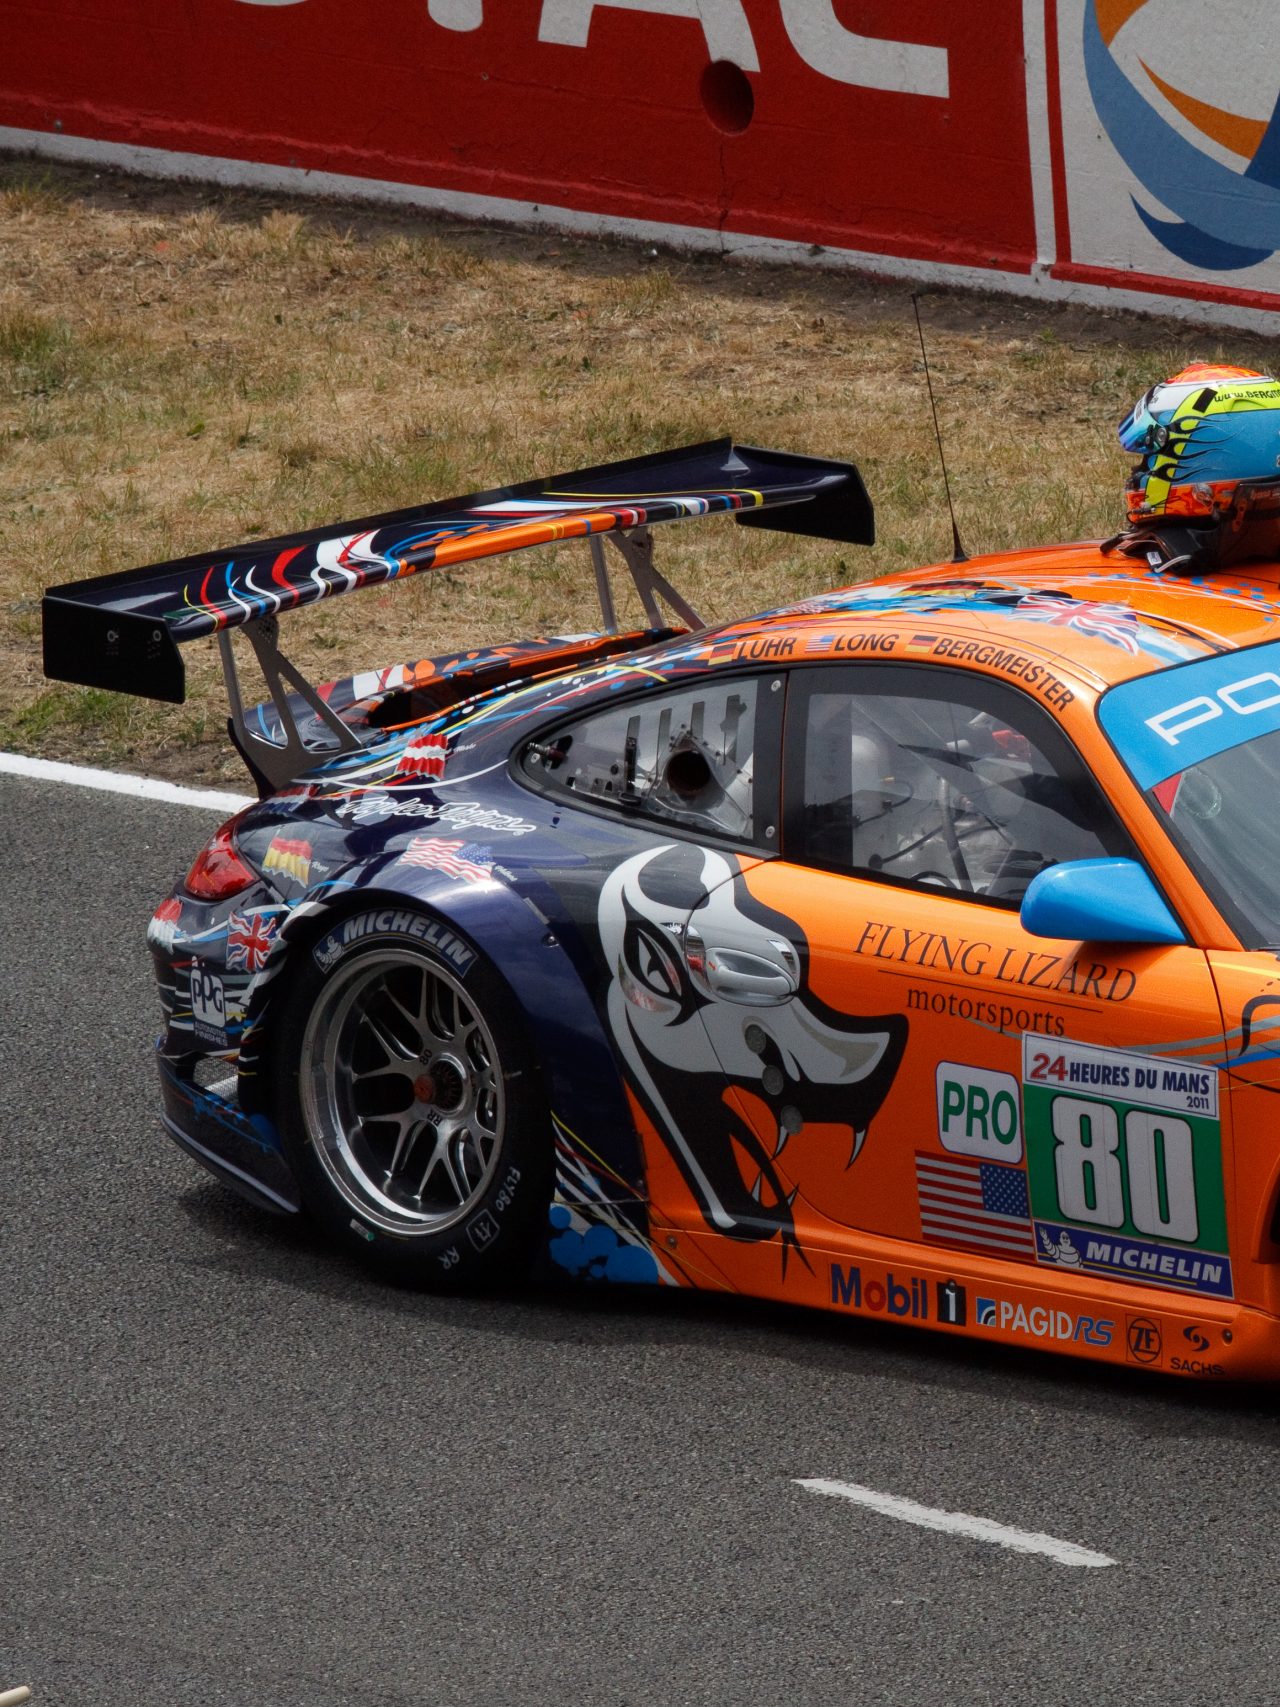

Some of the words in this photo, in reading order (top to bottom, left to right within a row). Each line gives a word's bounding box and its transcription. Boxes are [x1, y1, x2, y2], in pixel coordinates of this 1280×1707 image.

[737, 636, 797, 660] LUHR
[834, 634, 899, 653] LONG
[933, 638, 1076, 713] BERGMEISTER
[343, 910, 473, 966] MICHELIN
[853, 921, 992, 977] FLYING
[994, 948, 1137, 1002] LIZARD
[192, 967, 223, 1013] PPG
[906, 988, 1065, 1036] motorsports
[1030, 1053, 1068, 1081] 24
[1069, 1062, 1130, 1087] HEURES
[1134, 1068, 1157, 1090] DU
[1162, 1073, 1210, 1095] MANS
[942, 1080, 1018, 1145] PRO
[1186, 1095, 1210, 1110] 2011
[1051, 1094, 1200, 1244] 80
[1086, 1241, 1222, 1284] MICHELIN
[831, 1263, 928, 1320] Mobil
[1001, 1300, 1073, 1340] PAGID
[1073, 1316, 1116, 1347] RS
[1131, 1325, 1160, 1356] ZF
[1169, 1356, 1225, 1377] SACHS
